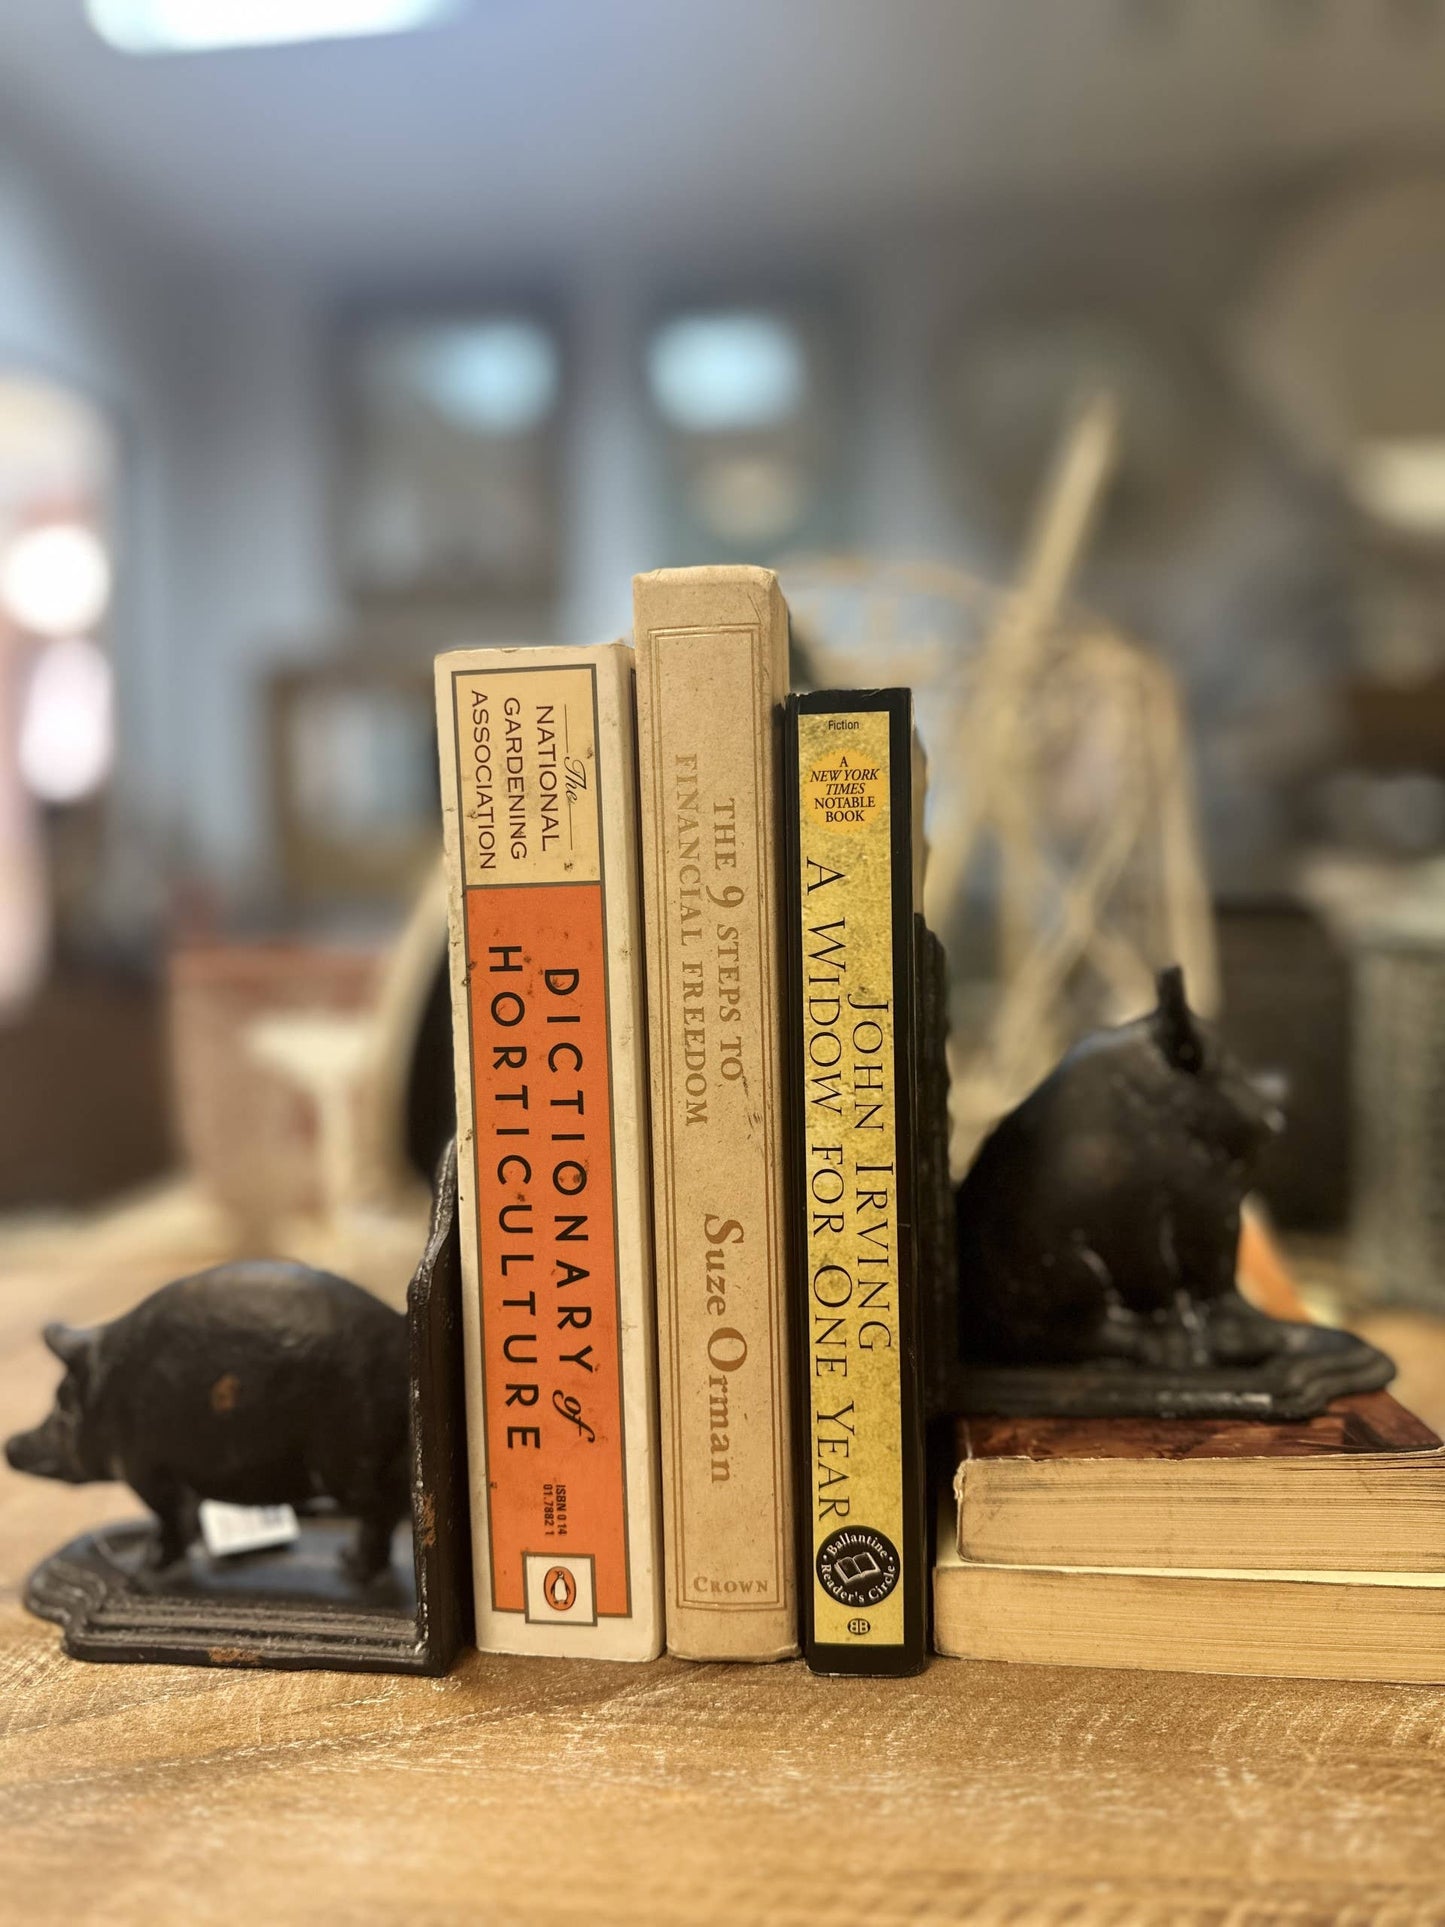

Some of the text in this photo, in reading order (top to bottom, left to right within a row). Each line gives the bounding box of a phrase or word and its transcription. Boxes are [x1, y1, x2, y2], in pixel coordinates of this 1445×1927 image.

[828, 719, 860, 731] Fiction
[839, 756, 848, 768] A
[471, 689, 496, 870] ASSOCIATION
[504, 697, 527, 860] GARDENING
[536, 705, 560, 852] NATIONAL
[564, 757, 587, 804] The
[810, 768, 880, 783] NEW YORK
[814, 796, 876, 810] NOTABLE
[825, 810, 865, 823] BOOK
[826, 782, 866, 796] TIMES
[675, 753, 708, 1127] FINANCIAL FREEDOM
[705, 797, 745, 1081] THE 9 STEPS TO
[488, 945, 541, 1449] HORTICULTURE
[544, 968, 596, 1443] DICTIONARY of
[806, 855, 855, 1522] A WIDOW FOR ONE YEAR
[847, 993, 894, 1352] JOHN IRVING
[703, 1213, 748, 1484] Suze Orman
[555, 1484, 567, 1511] ISBN
[826, 1532, 888, 1558] Ballantine
[821, 1563, 896, 1603] Reader's Circle
